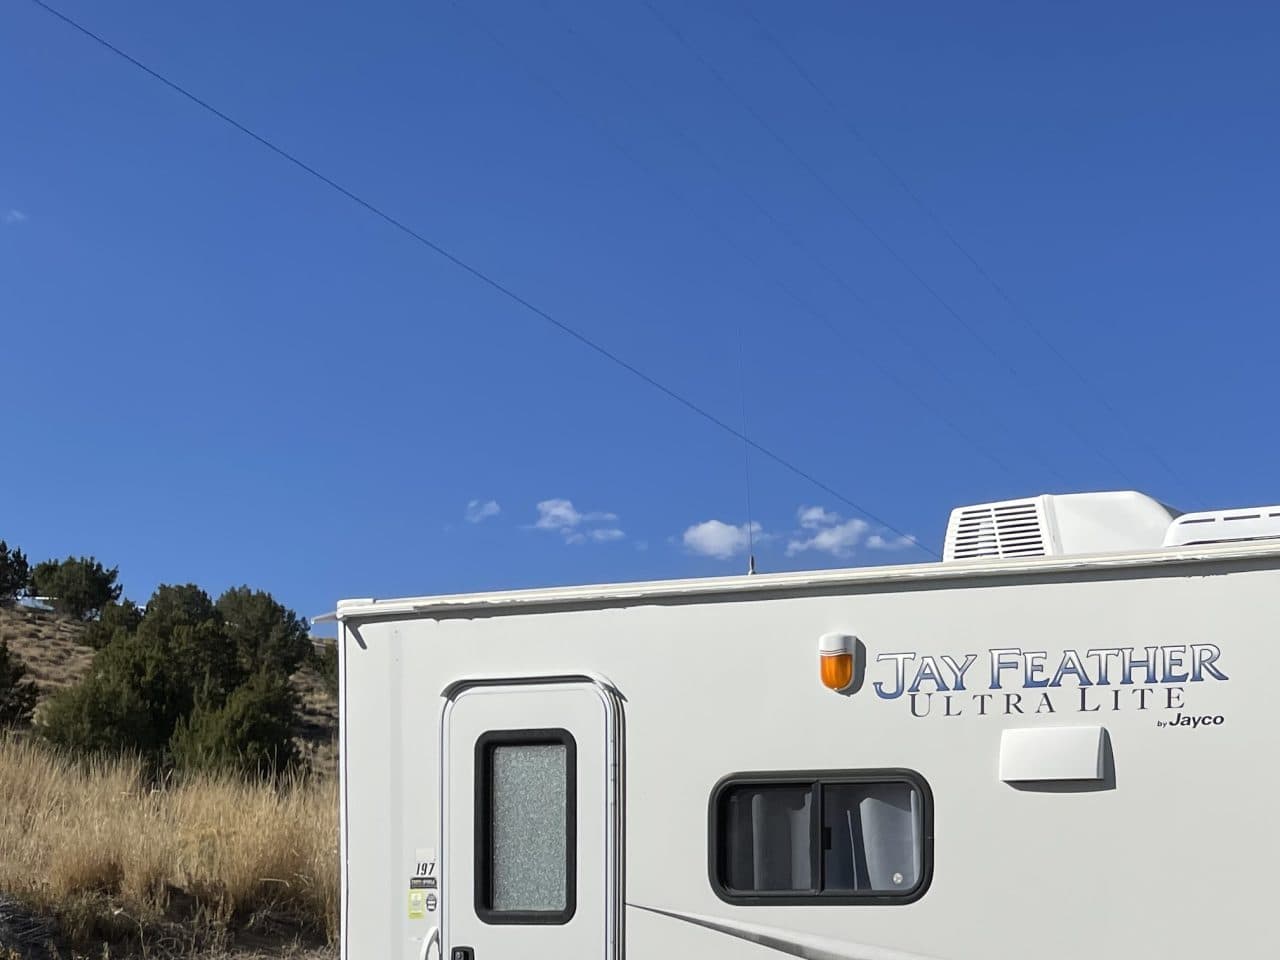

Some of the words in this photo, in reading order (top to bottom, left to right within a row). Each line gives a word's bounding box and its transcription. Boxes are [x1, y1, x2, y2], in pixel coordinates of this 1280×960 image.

[872, 652, 977, 700] JAY
[988, 643, 1230, 690] FEATHER
[908, 691, 1056, 718] ULTRA
[1077, 686, 1186, 713] LITE
[1156, 720, 1168, 729] by
[1168, 712, 1226, 729] Jayco
[416, 862, 436, 876] 197
